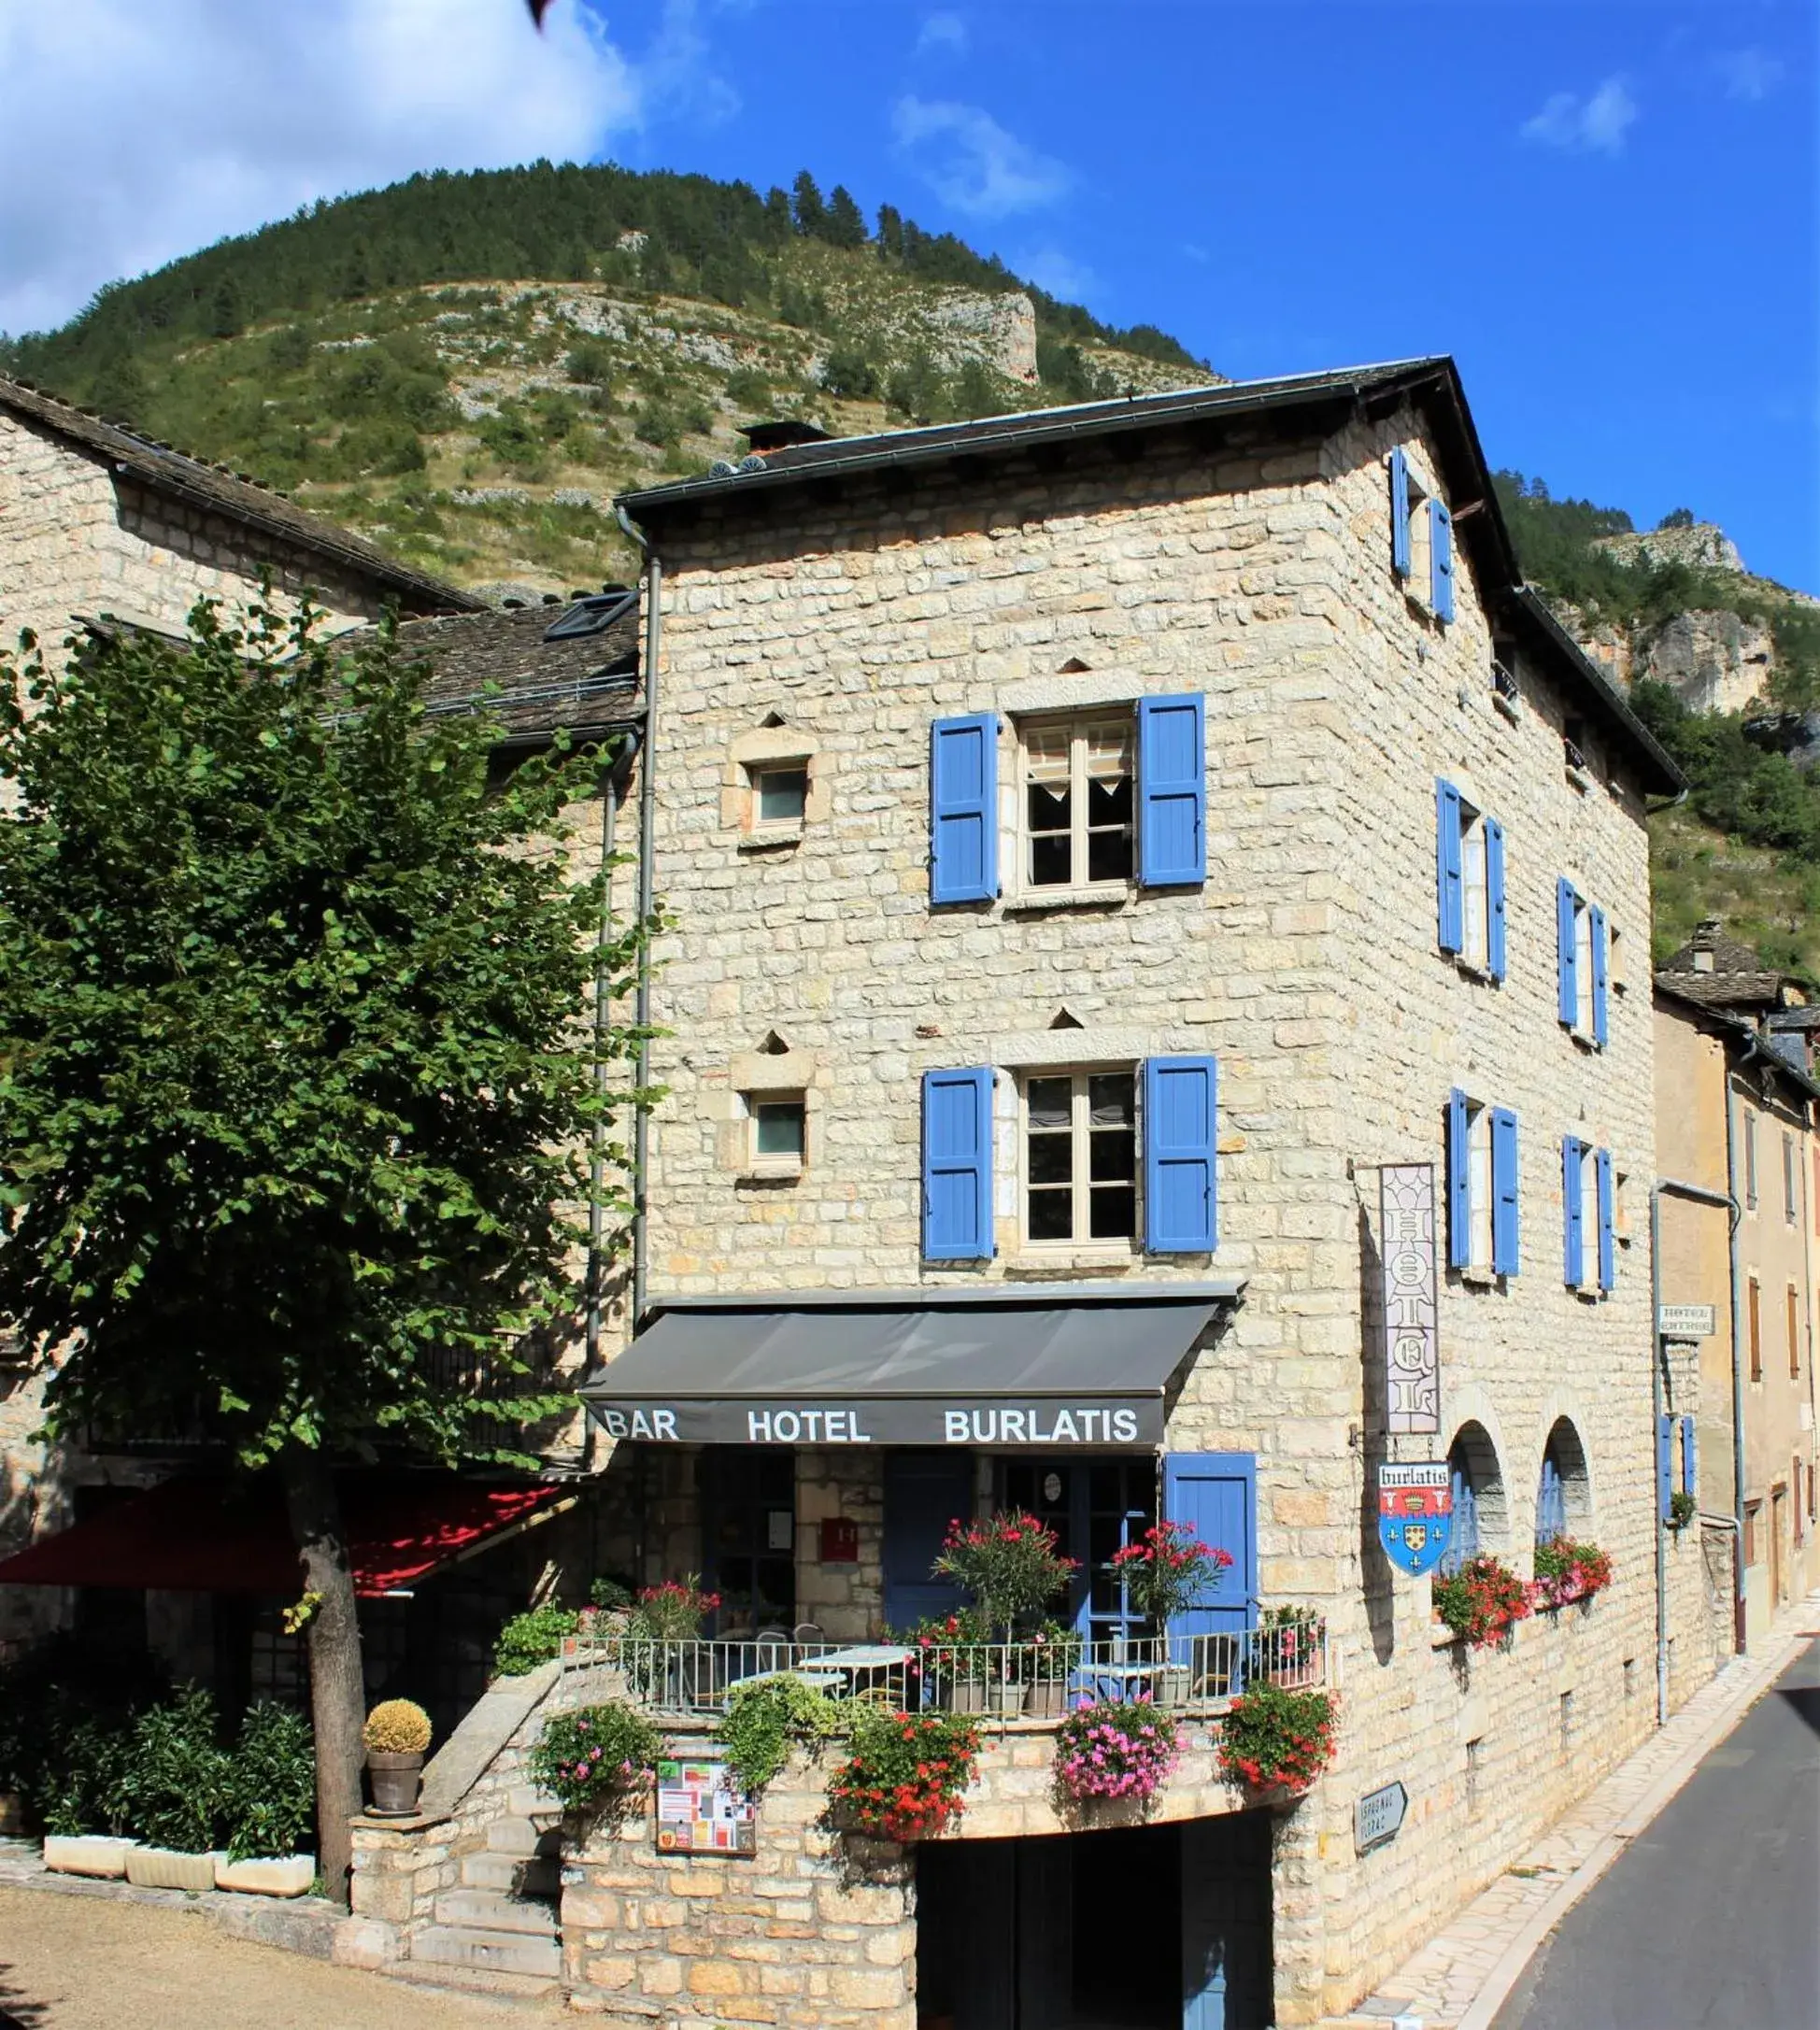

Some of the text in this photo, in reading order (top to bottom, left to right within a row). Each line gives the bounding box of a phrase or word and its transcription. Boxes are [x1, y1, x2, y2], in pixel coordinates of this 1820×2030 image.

[1386, 1209, 1436, 1414] HOTEL
[604, 1409, 1138, 1442] BAR HOTEL BURLATIS
[1382, 1468, 1447, 1484] burlatis
